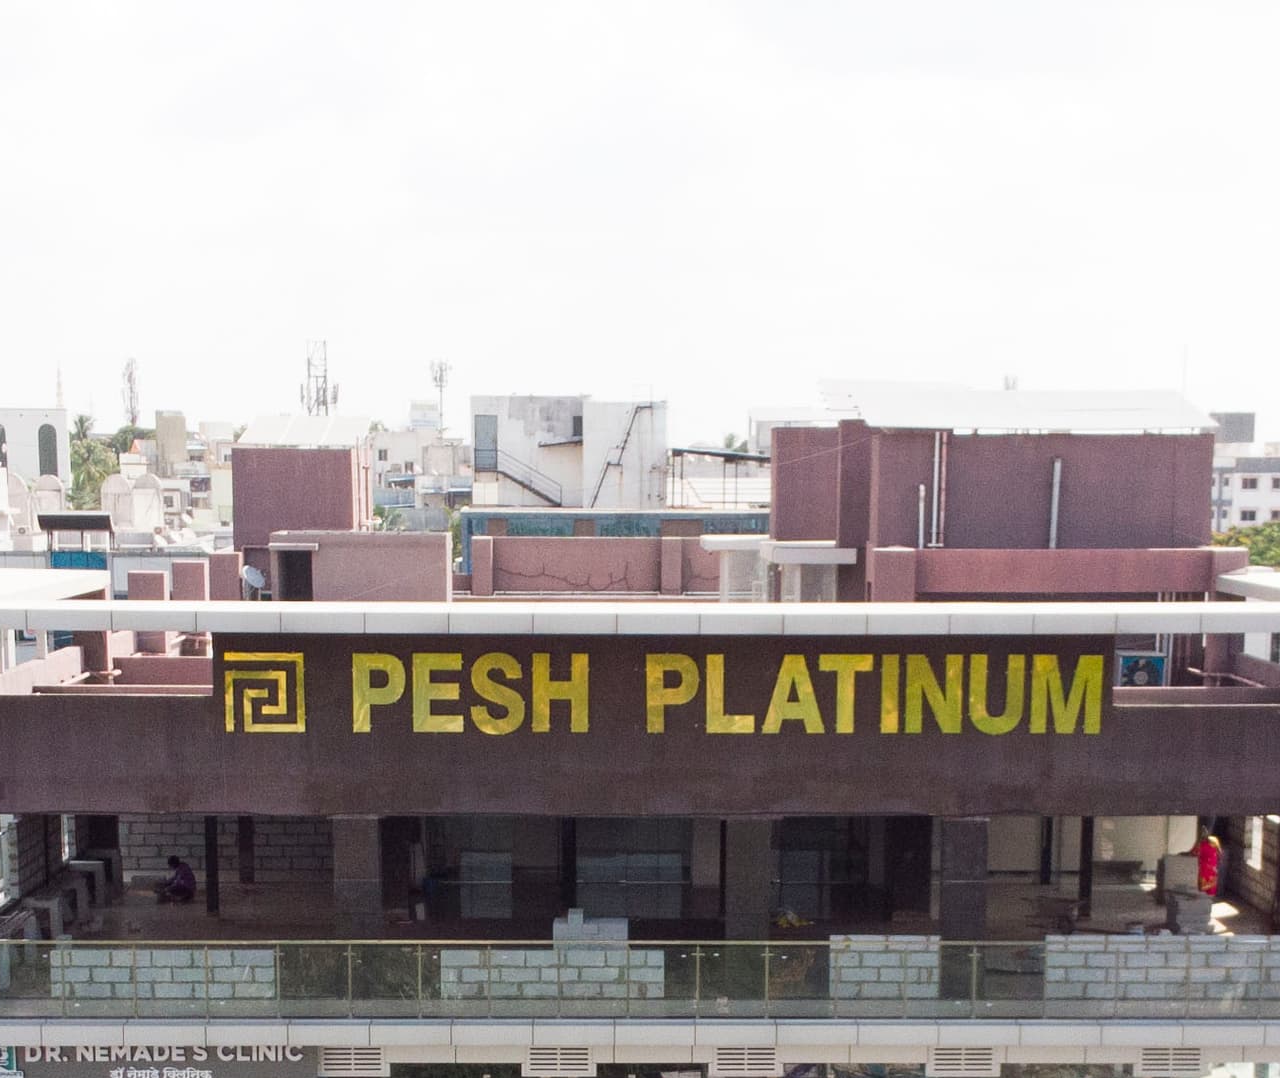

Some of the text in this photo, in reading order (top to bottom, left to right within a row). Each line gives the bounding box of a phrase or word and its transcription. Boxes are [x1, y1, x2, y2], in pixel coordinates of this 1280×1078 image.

[352, 652, 1104, 735] PESH PLATINUM
[25, 1046, 304, 1063] DR. NEMADES CLINIC
